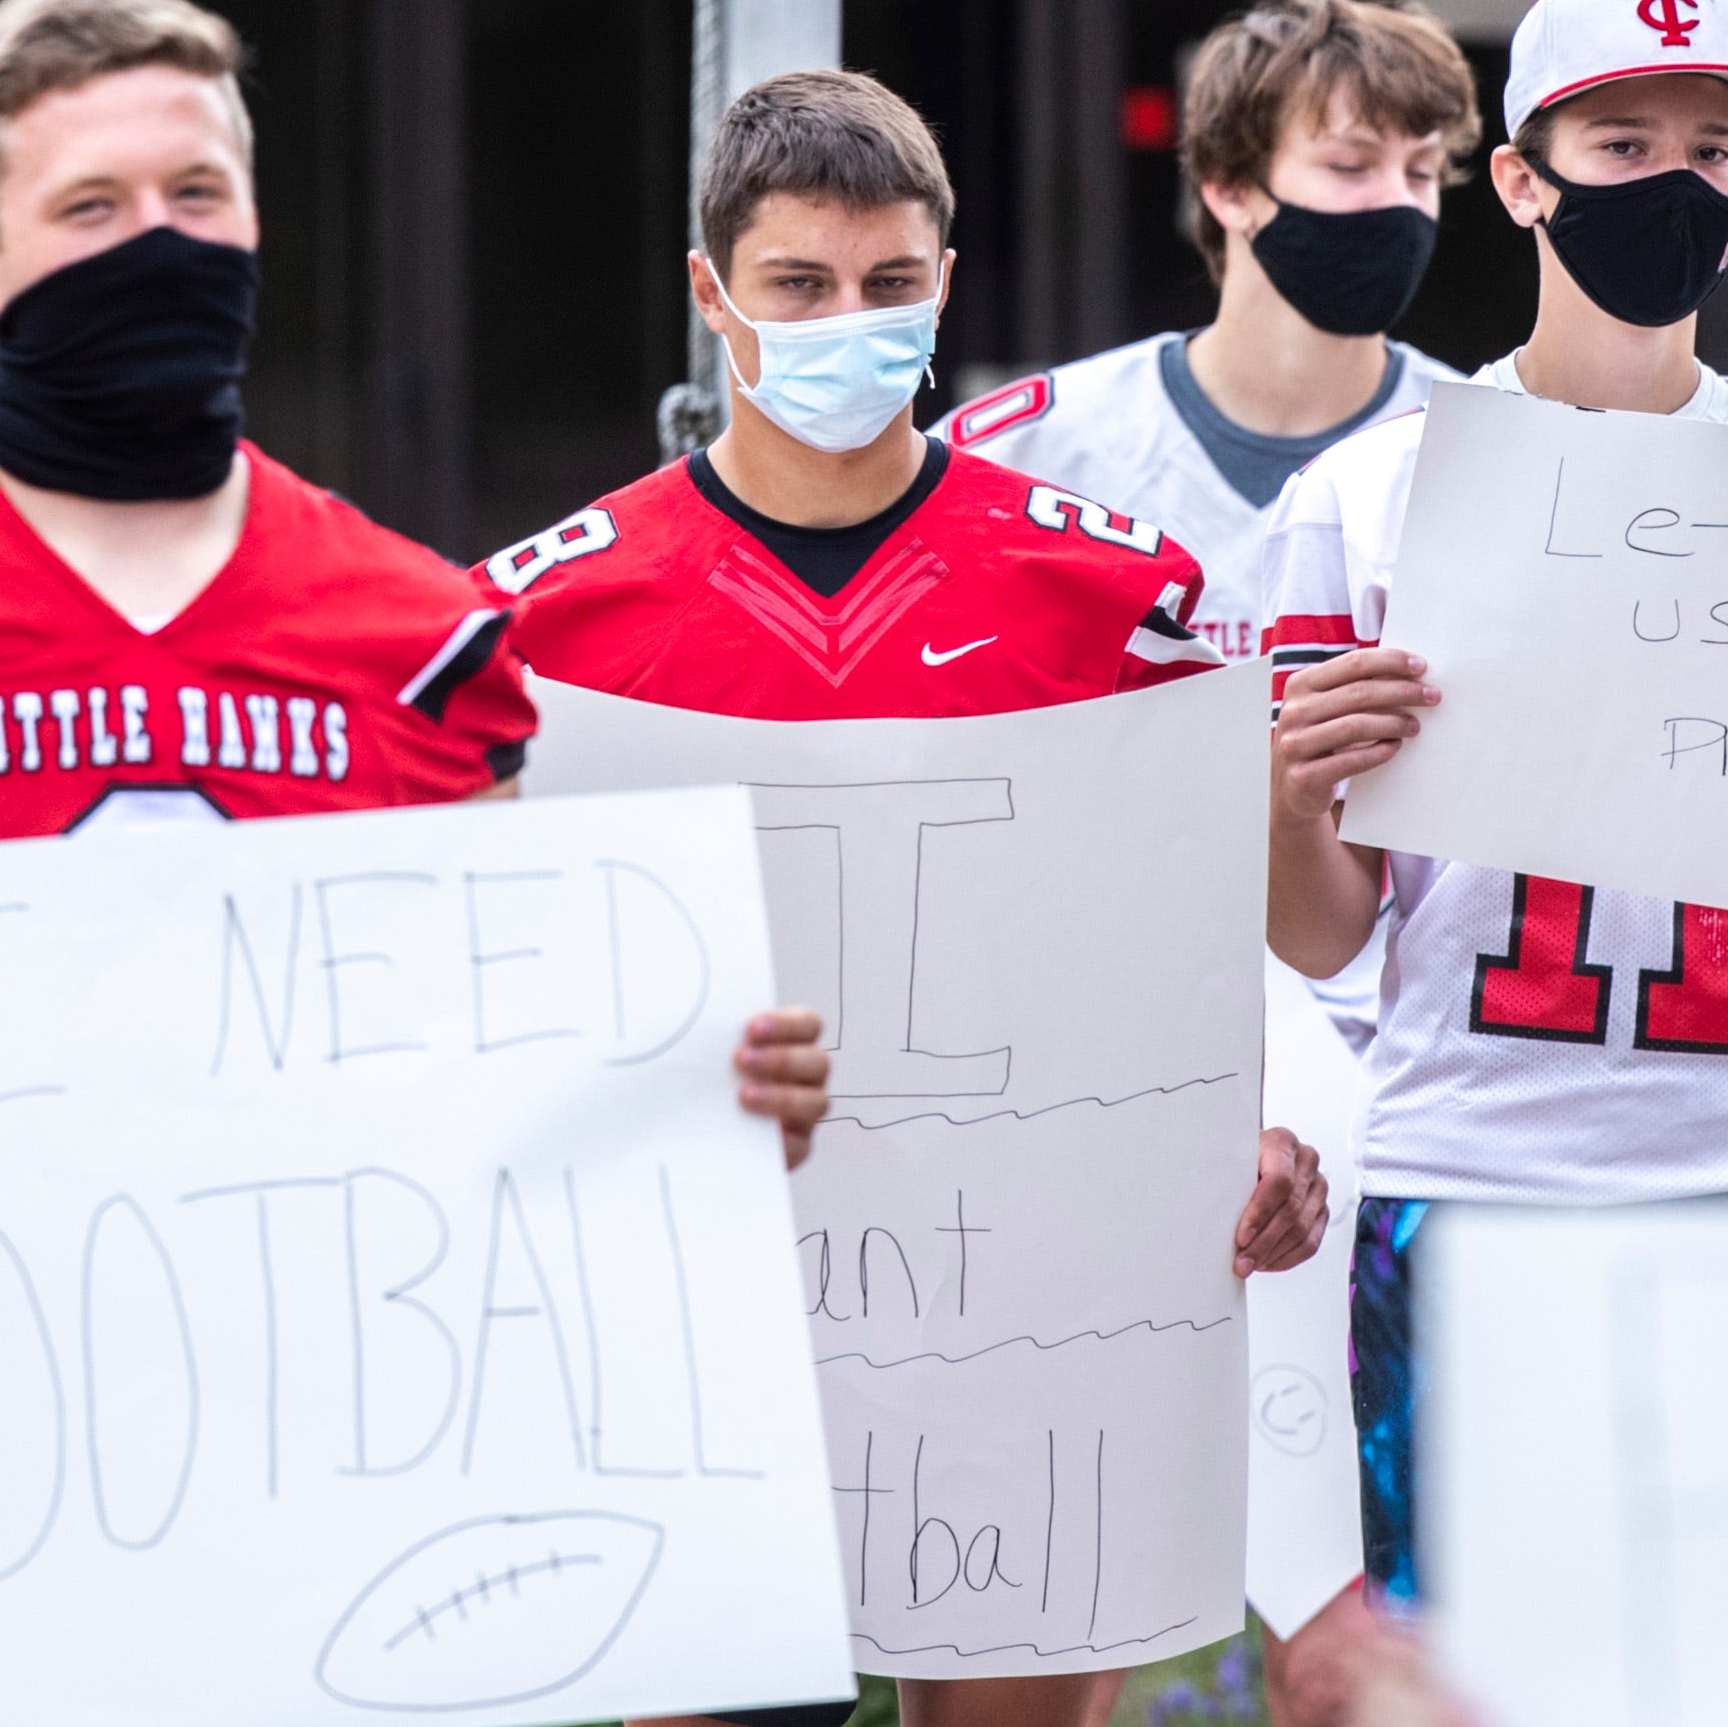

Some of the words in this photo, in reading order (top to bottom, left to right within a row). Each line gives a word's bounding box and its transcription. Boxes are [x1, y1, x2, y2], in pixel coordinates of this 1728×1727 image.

[1025, 483, 1163, 558] 2
[208, 857, 710, 1077] NEED
[795, 1188, 993, 1322] ant
[830, 1428, 1103, 1642] tball
